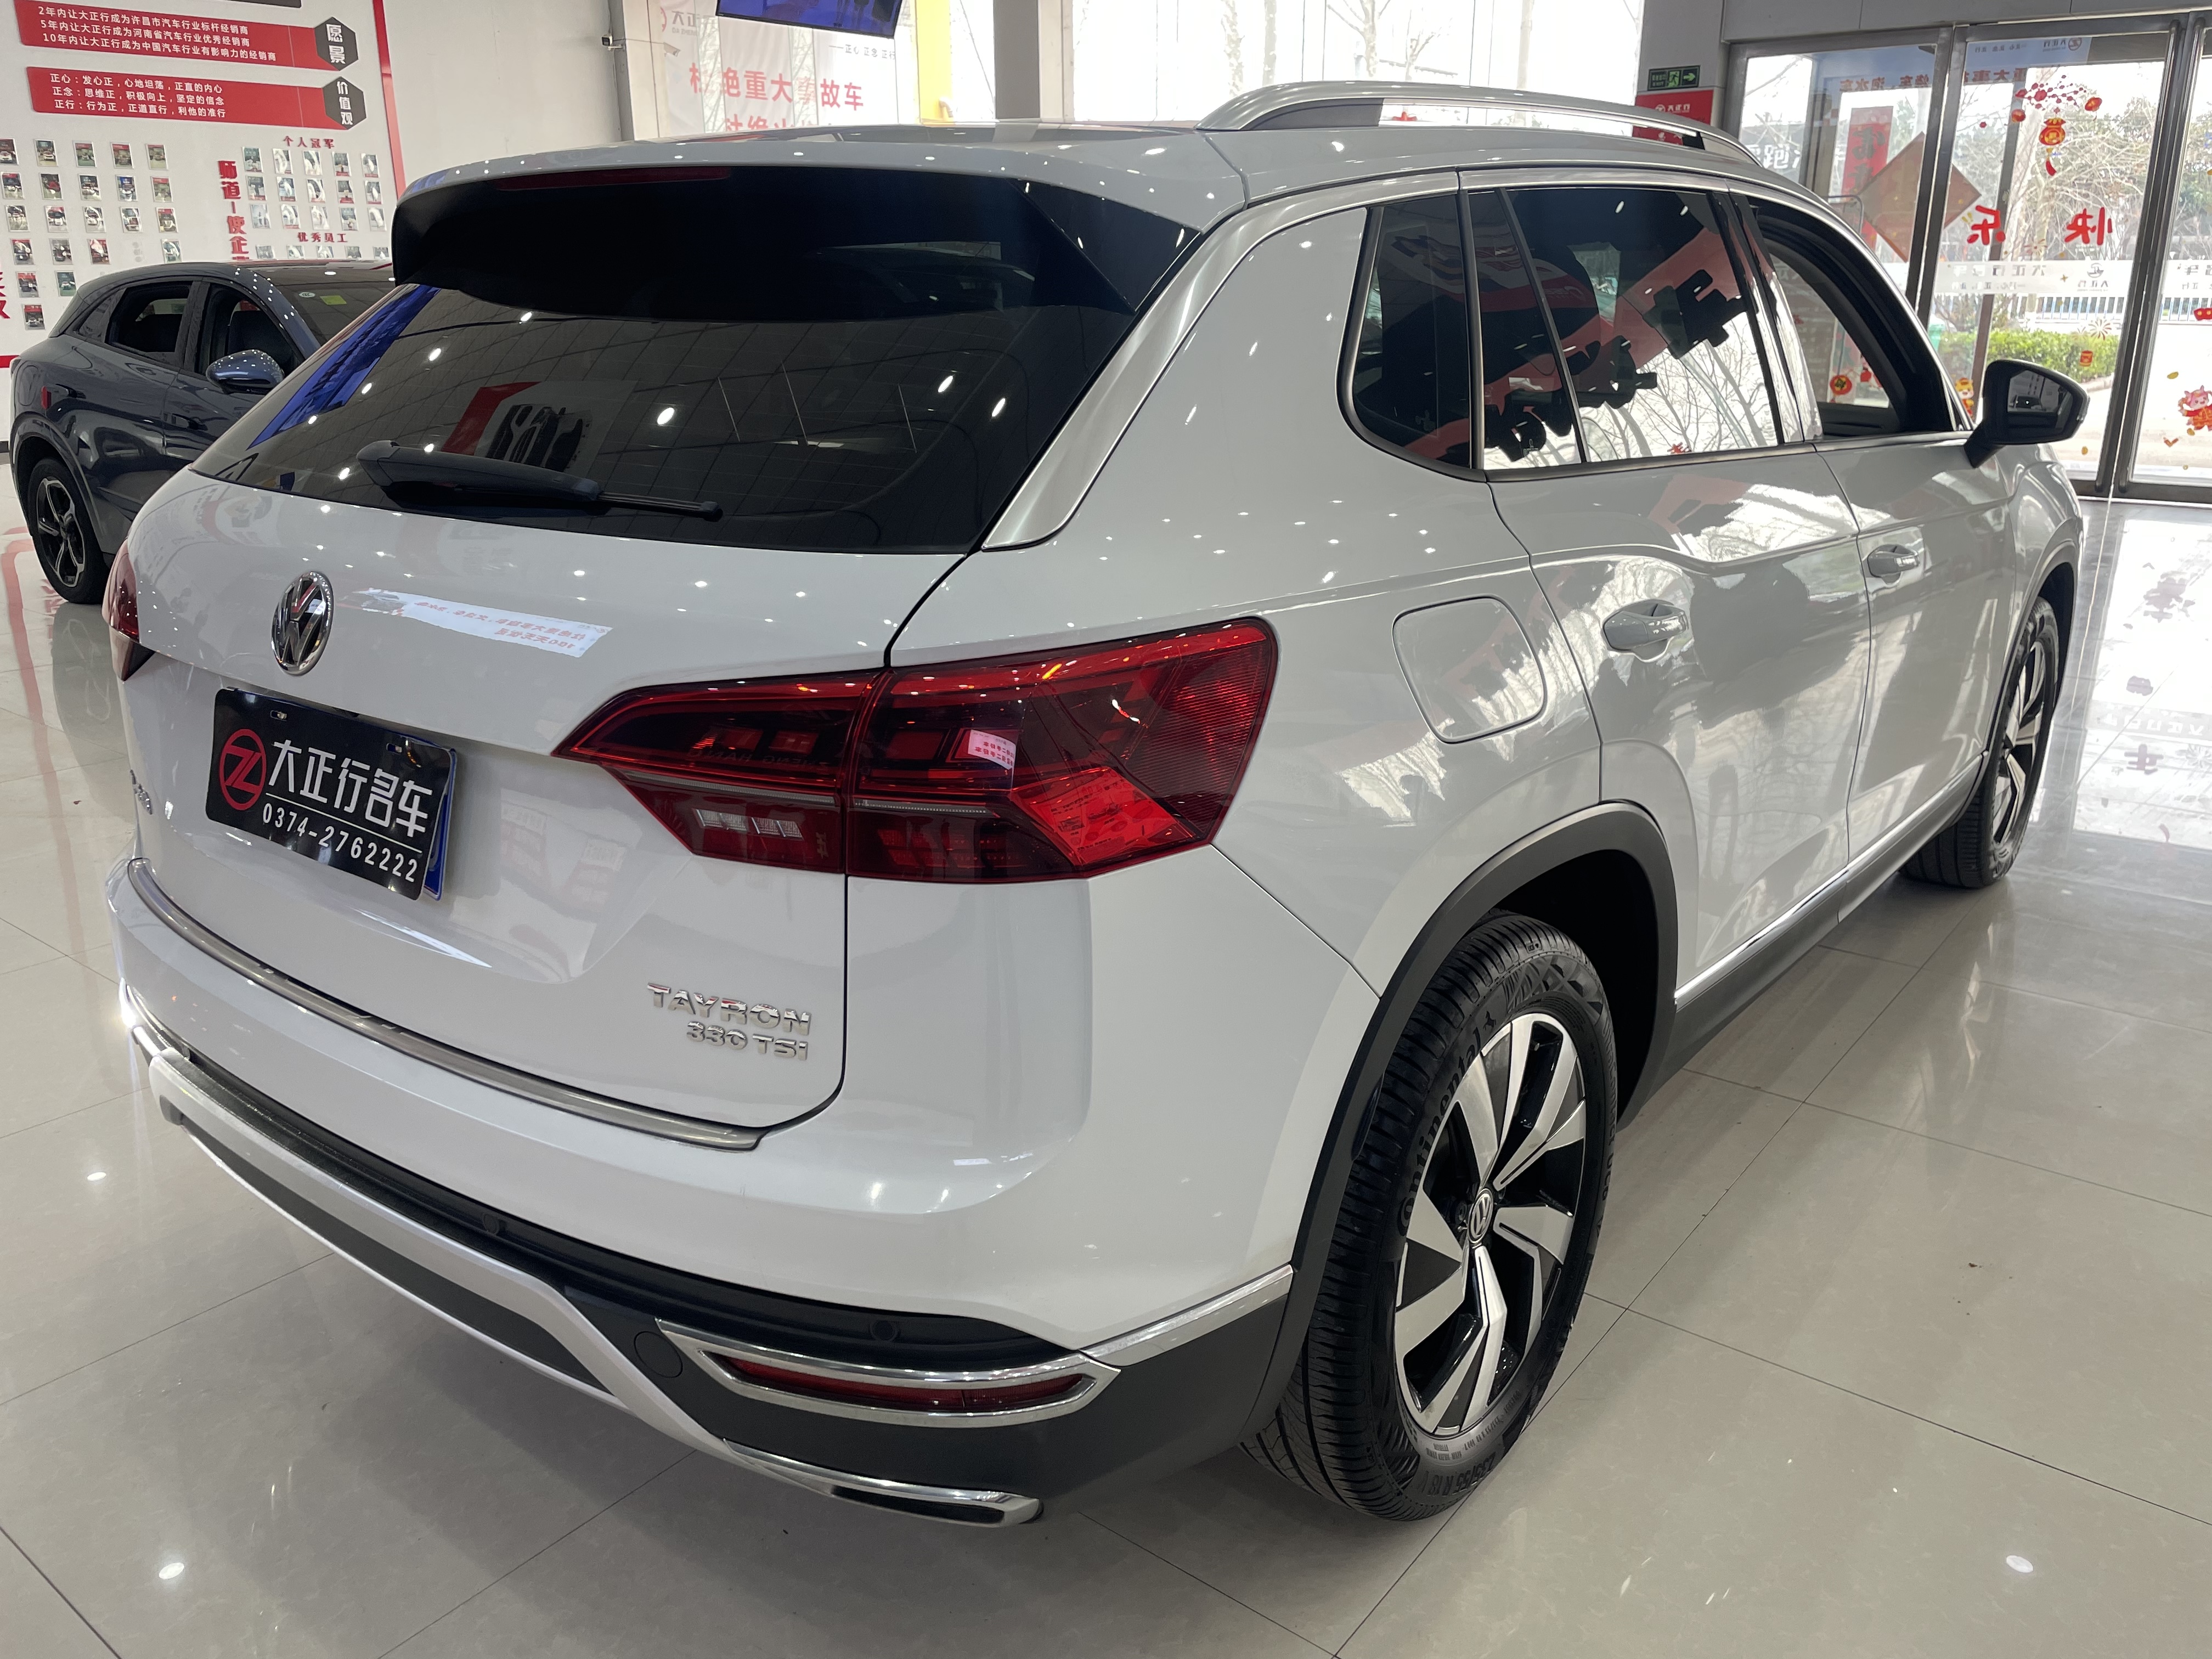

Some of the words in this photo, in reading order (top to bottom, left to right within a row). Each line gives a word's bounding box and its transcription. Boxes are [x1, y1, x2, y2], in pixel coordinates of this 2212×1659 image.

[38, 6, 249, 35] 2年内让大正行成为许昌市汽车行业标杆经销商
[41, 20, 250, 47] 5年内让大正行成为河南省汽车行业优秀经销商
[43, 33, 276, 61] 10年内让大正行成为中国汽车行业有影响力的经销商
[326, 24, 346, 64] 愿景
[336, 81, 353, 125] 价值观
[284, 136, 335, 149] 个人冠军
[297, 232, 348, 242] 优秀员工
[269, 739, 432, 837] 大正行名车
[263, 803, 418, 882] 0374-2762222
[647, 982, 812, 1035] TAYRON
[687, 1020, 748, 1051] 330
